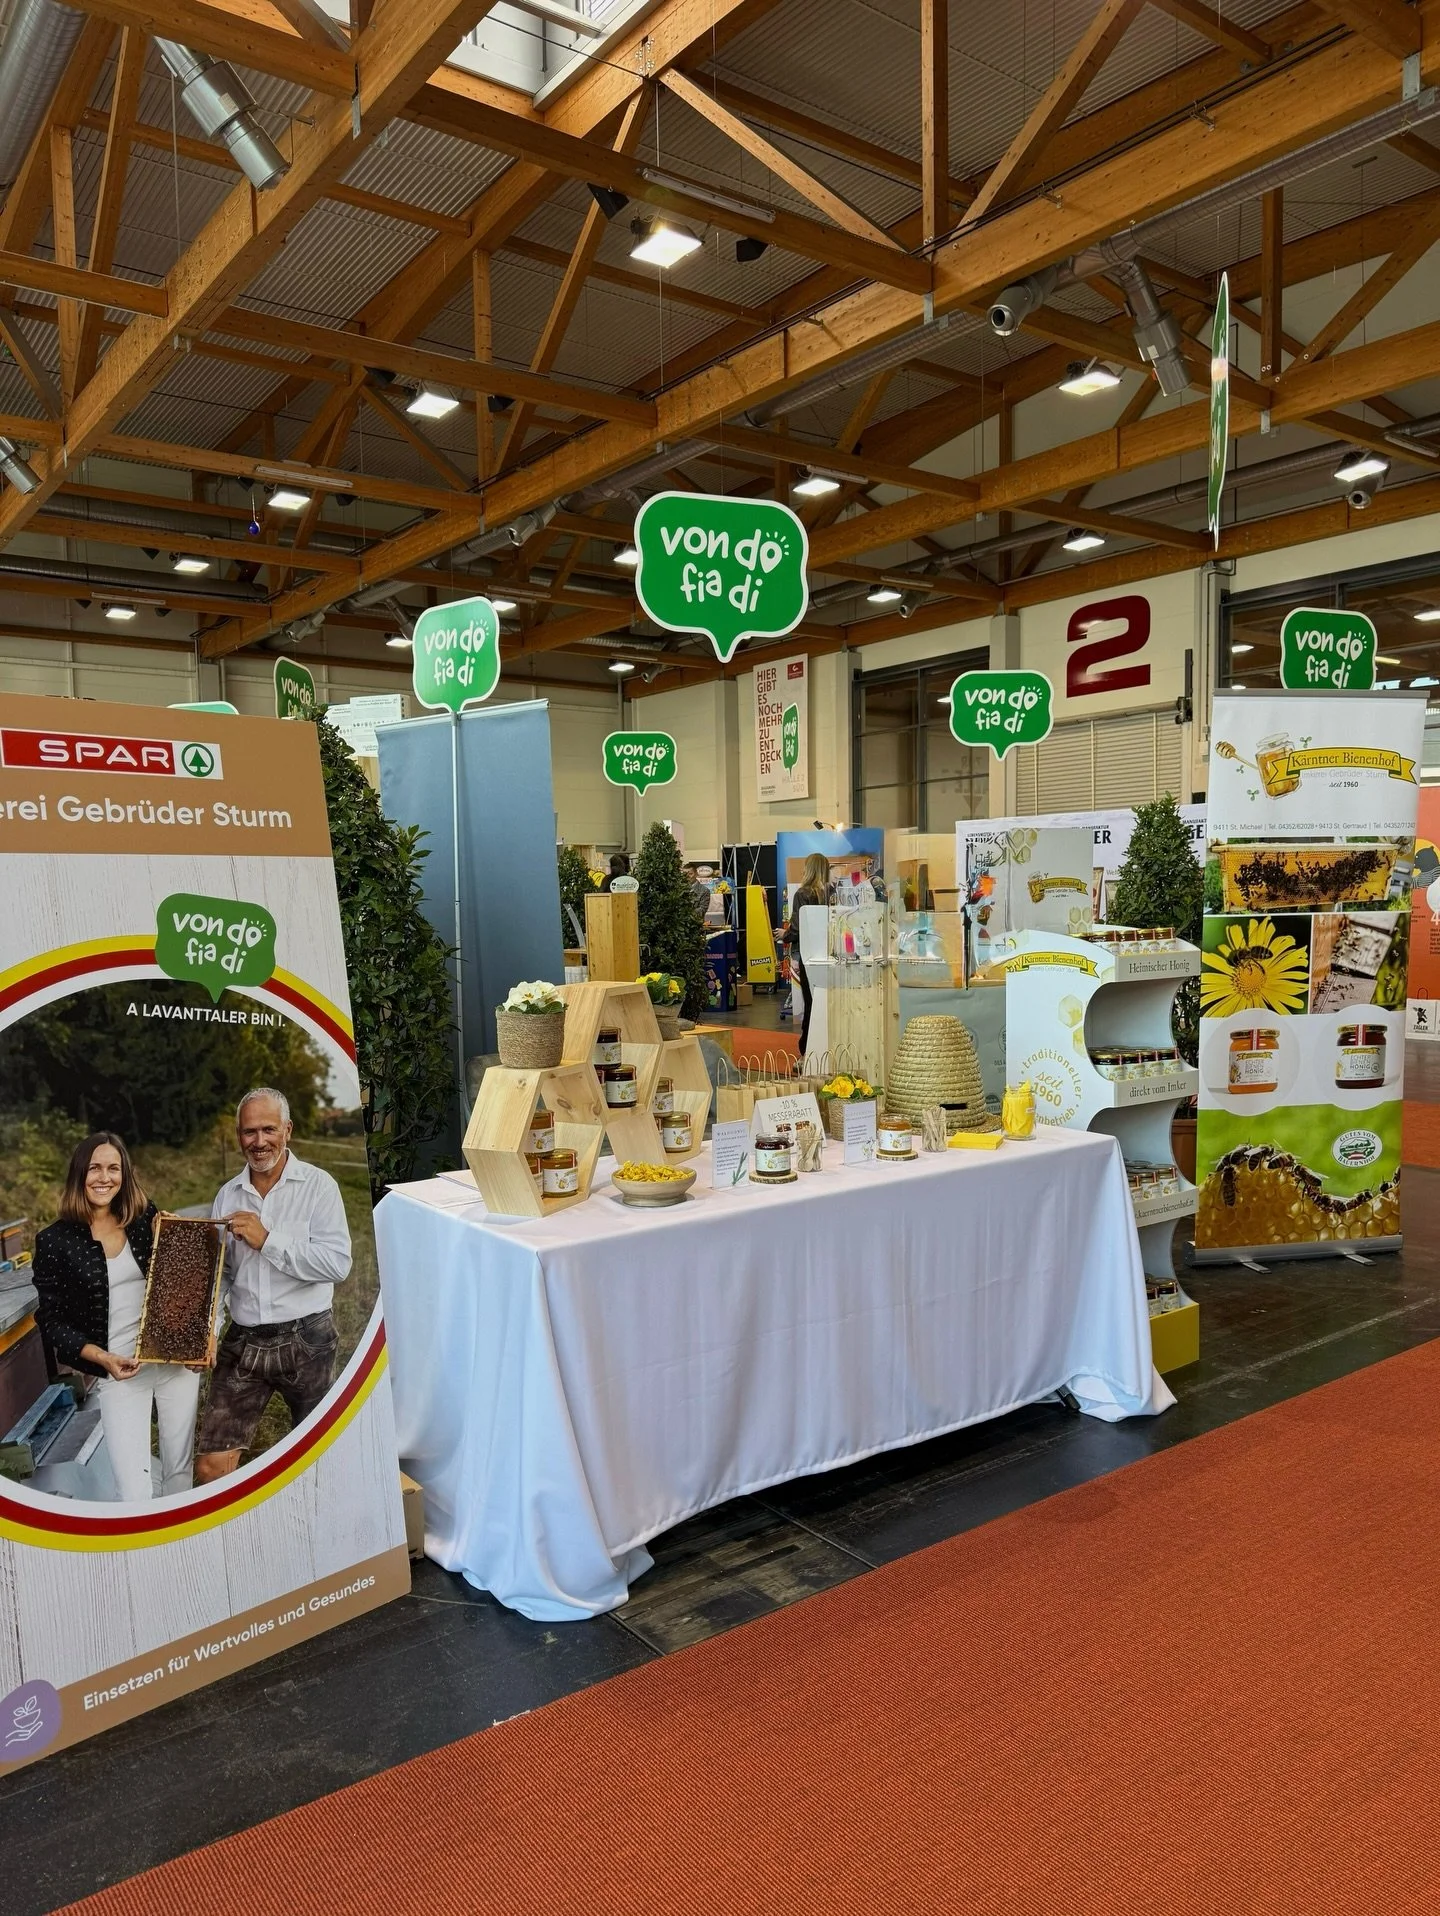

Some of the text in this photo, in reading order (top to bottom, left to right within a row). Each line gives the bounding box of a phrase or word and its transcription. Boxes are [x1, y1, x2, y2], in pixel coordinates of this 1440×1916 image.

[660, 526, 729, 559] von
[680, 562, 763, 614] fia di
[424, 628, 457, 655] von
[1067, 595, 1150, 698] 2
[1295, 630, 1333, 652] von
[434, 655, 475, 687] fia di
[757, 668, 776, 682] HIER
[1305, 655, 1351, 689] fia di
[281, 677, 299, 698] von
[757, 680, 776, 693] GIBT
[758, 694, 767, 705] ES
[965, 688, 1005, 706] von
[758, 702, 782, 716] NOCH
[759, 714, 782, 728] MEHR
[976, 708, 1025, 734] fia di
[759, 729, 769, 740] ZU
[39, 739, 170, 769] SPAR
[613, 744, 643, 757] von
[760, 739, 775, 752] ENT
[760, 750, 781, 763] DECK
[1292, 751, 1398, 767] Kärntner Bienenhof
[622, 758, 658, 777] fia di
[761, 764, 771, 774] EN
[0, 795, 292, 828] rei Gebrüder Sturm
[173, 912, 223, 937] von
[185, 937, 246, 974] fia di
[1129, 960, 1190, 973] Heimischer Honig
[126, 1002, 138, 1015] A
[142, 1003, 247, 1024] LAVANTTALER
[250, 1012, 274, 1026] BIN
[1022, 1048, 1082, 1099] traditioneller
[1035, 1072, 1063, 1090] seit
[1033, 1082, 1062, 1107] 1960
[1129, 1081, 1187, 1098] direkt vom Imker
[790, 1099, 798, 1108] %
[768, 1108, 813, 1121] MESSERABATT
[83, 1573, 376, 1711] Einsetzen für Wertvolles und Gesundes
